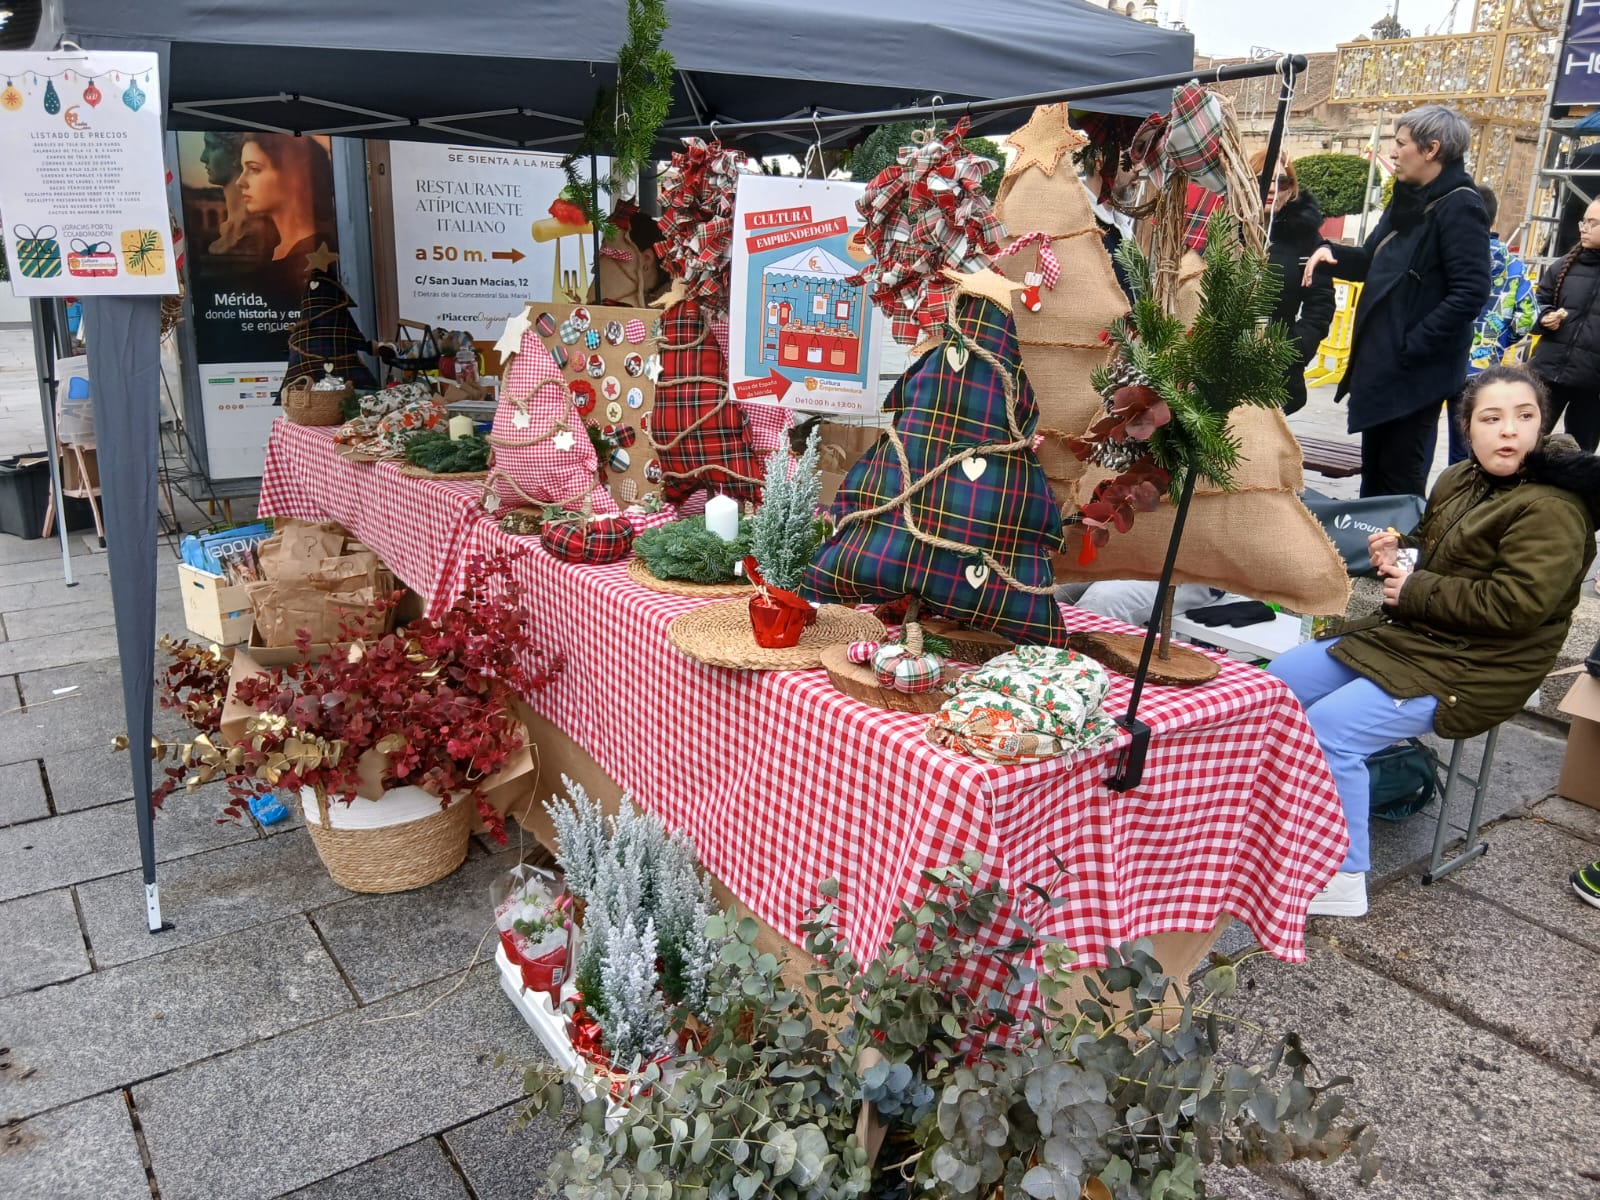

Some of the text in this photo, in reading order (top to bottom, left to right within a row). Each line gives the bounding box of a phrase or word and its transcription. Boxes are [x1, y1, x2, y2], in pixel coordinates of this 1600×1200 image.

[30, 131, 128, 139] LISTADO DE PRECIOS
[448, 154, 561, 169] SE SIENTA A LA MES
[416, 179, 522, 198] RESTAURANTE
[415, 197, 524, 217] ATÍPICAMENTE
[753, 209, 809, 226] CULTURA
[437, 219, 506, 234] ITALIANO
[755, 221, 840, 249] EMPRENDEDORA
[415, 246, 488, 262] a 50 m.
[415, 275, 529, 288] C/ San Juan Macías, 12
[214, 292, 268, 308] Mérida,
[205, 309, 236, 319] donde
[238, 309, 278, 319] historia
[279, 311, 286, 320] y
[241, 322, 254, 331] se
[819, 379, 841, 387] Cultura
